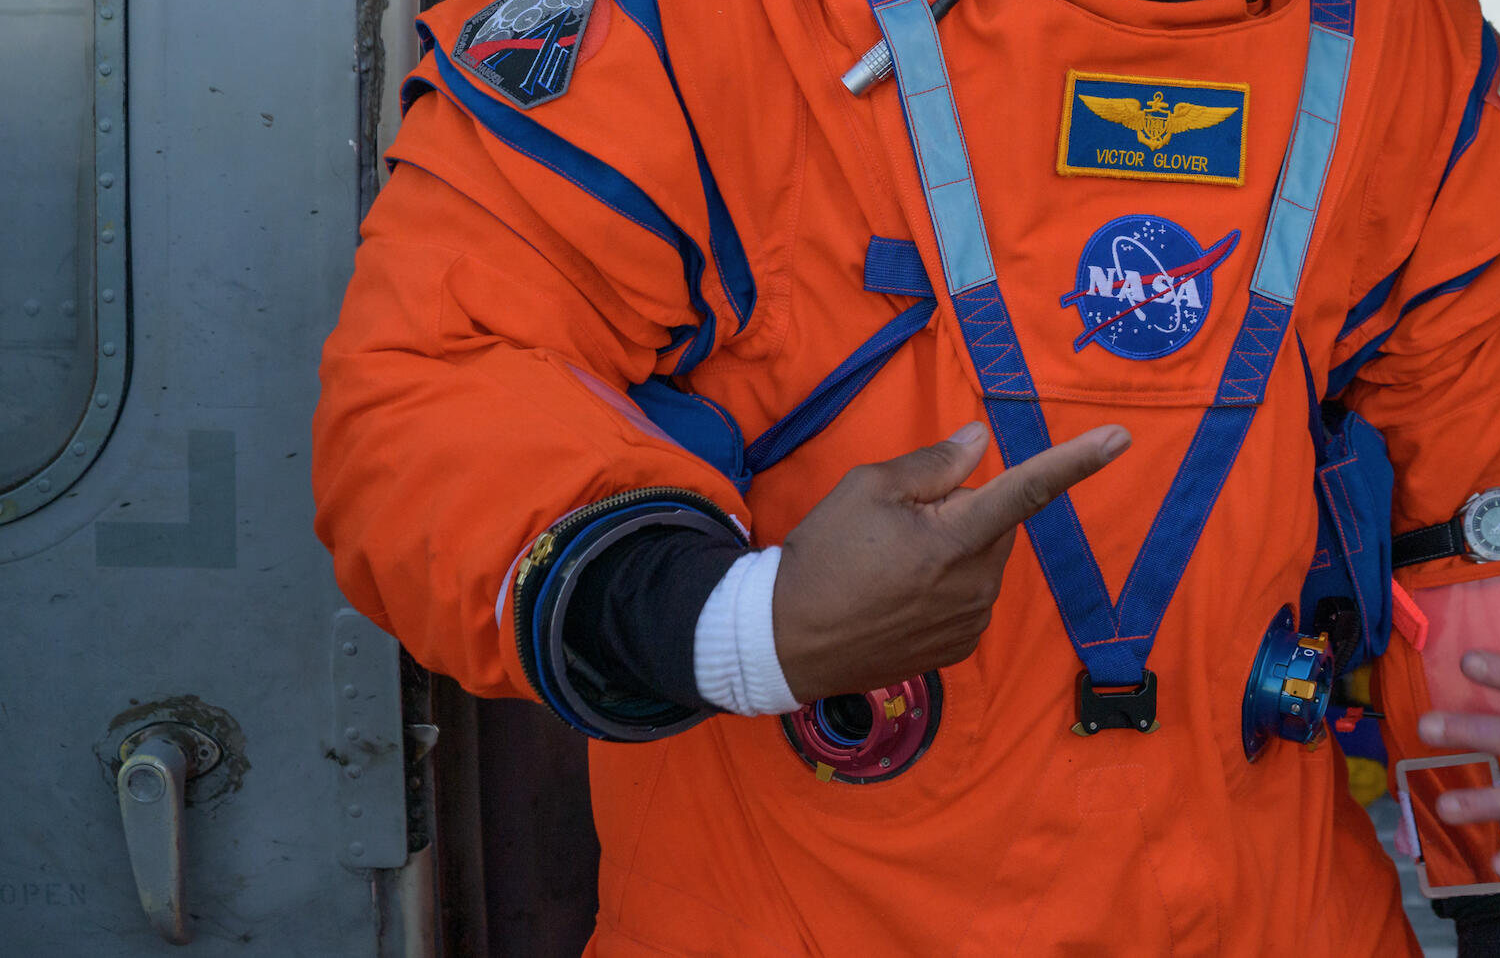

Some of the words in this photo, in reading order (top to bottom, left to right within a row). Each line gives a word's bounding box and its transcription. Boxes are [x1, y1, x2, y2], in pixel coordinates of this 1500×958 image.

[1096, 148, 1145, 168] VICTOR
[1152, 152, 1209, 173] GLOVER
[1086, 265, 1203, 309] NASA
[0, 882, 87, 906] OPEN
